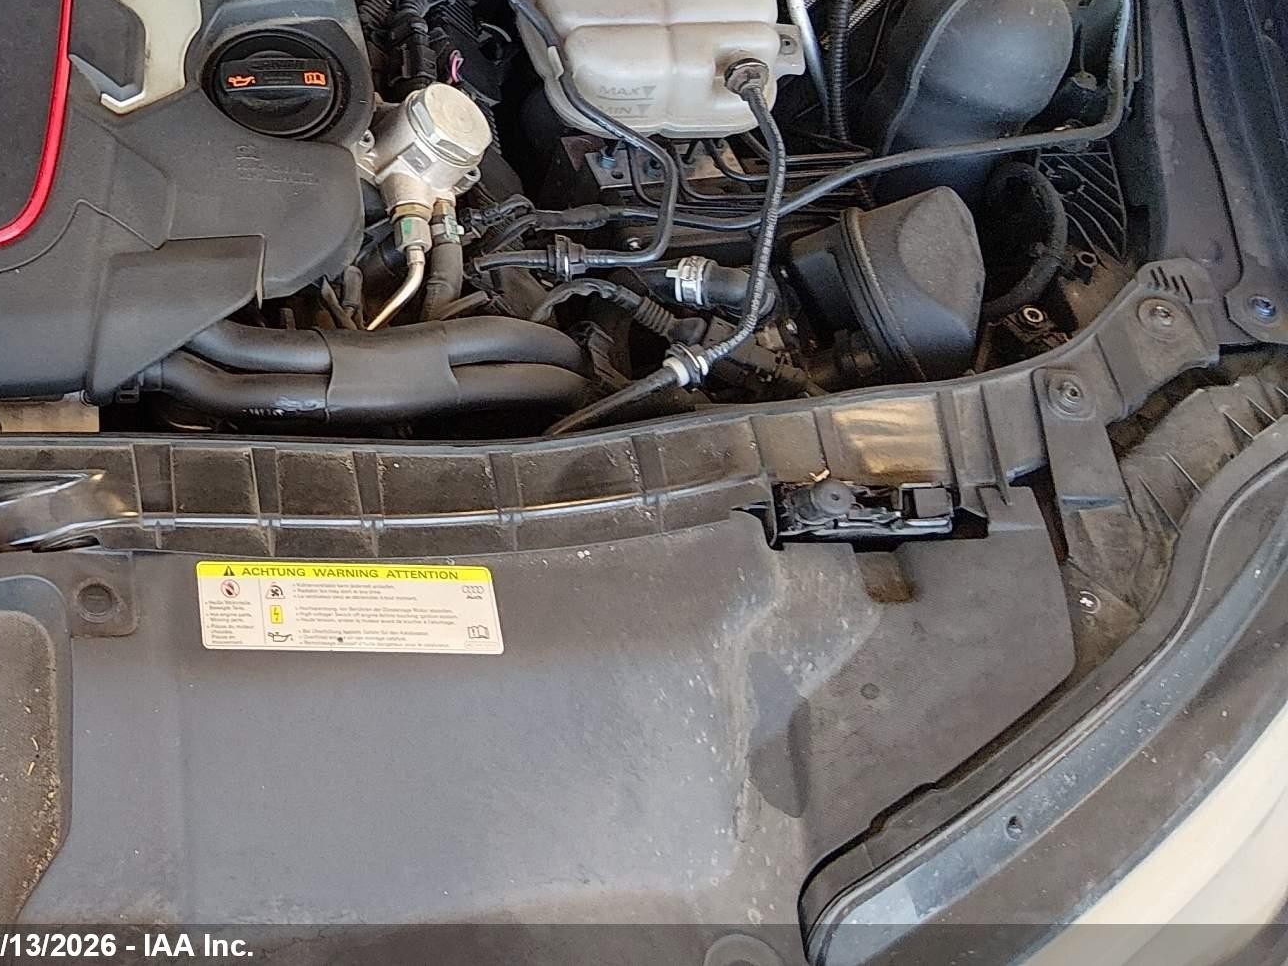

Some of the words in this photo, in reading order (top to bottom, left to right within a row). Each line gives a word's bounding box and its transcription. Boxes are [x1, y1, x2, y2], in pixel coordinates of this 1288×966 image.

[599, 86, 640, 96] MAX
[242, 567, 306, 577] ACHTUNG
[313, 569, 379, 578] WARNING
[386, 570, 459, 580] ATTENTION
